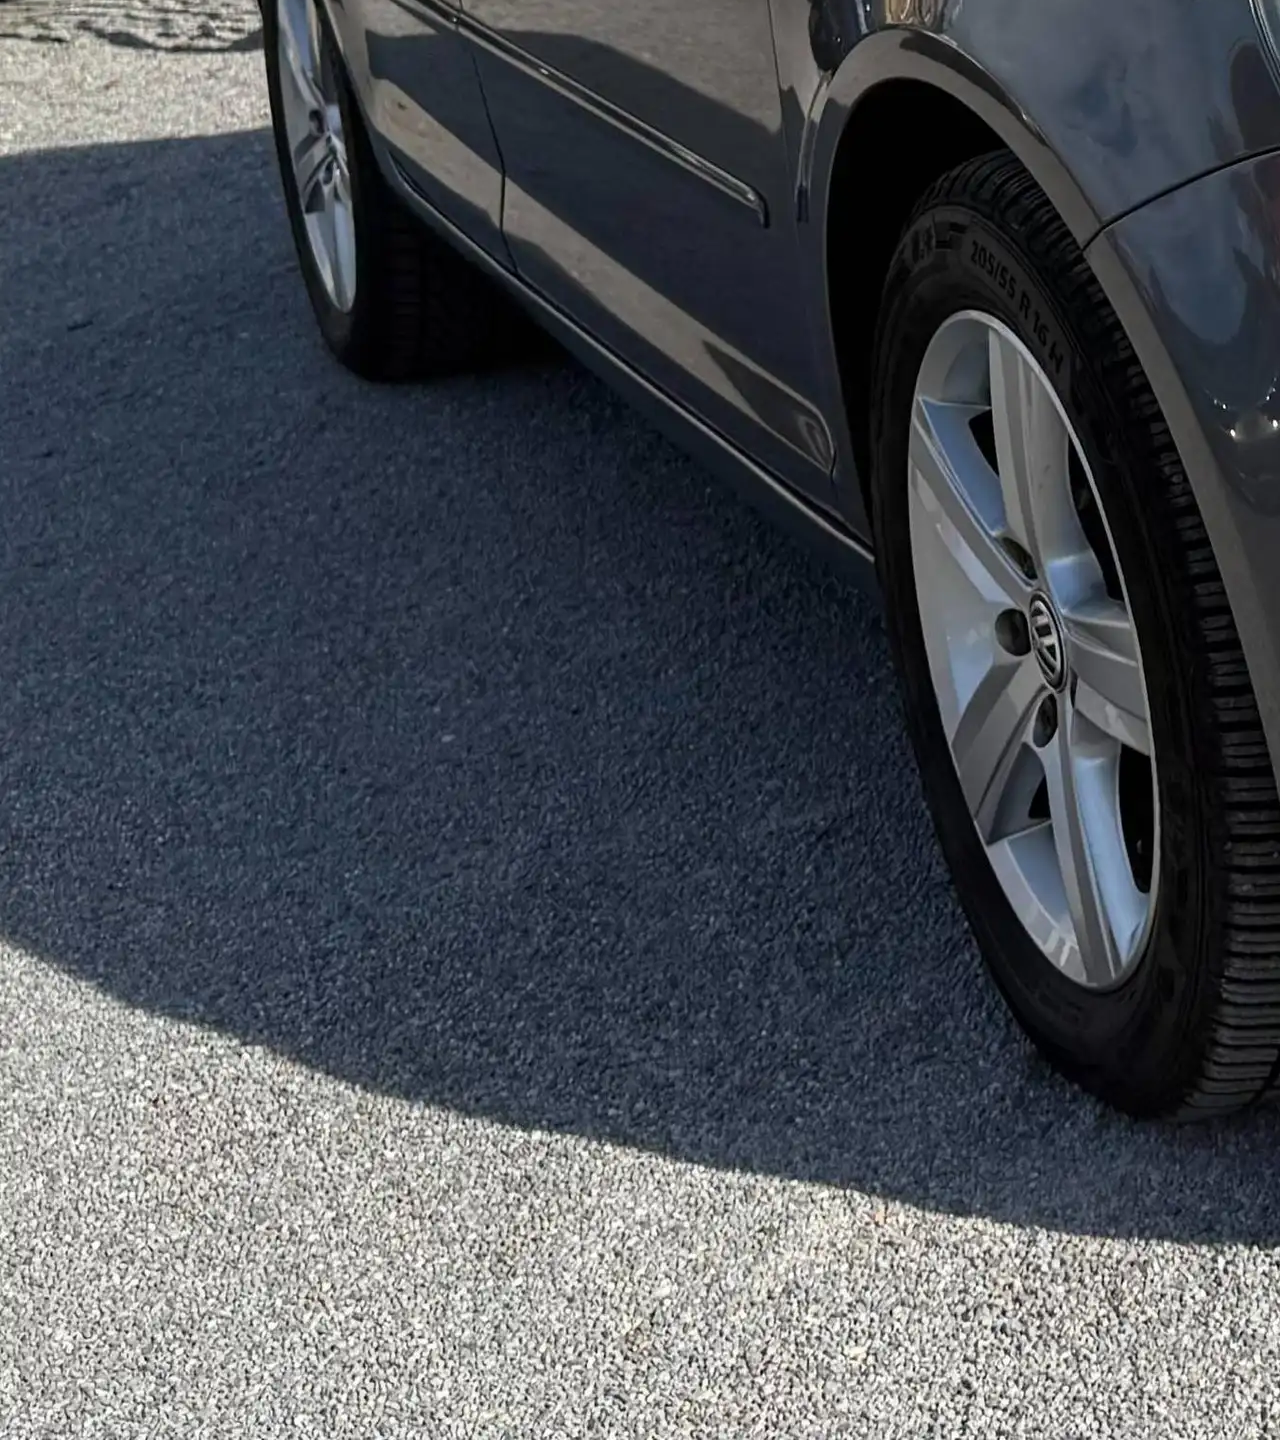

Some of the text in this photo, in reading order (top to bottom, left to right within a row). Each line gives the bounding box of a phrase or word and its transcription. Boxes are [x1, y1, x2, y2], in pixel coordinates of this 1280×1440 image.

[969, 240, 1018, 299] 205/55
[1018, 289, 1031, 320] R
[1031, 310, 1051, 346] 16
